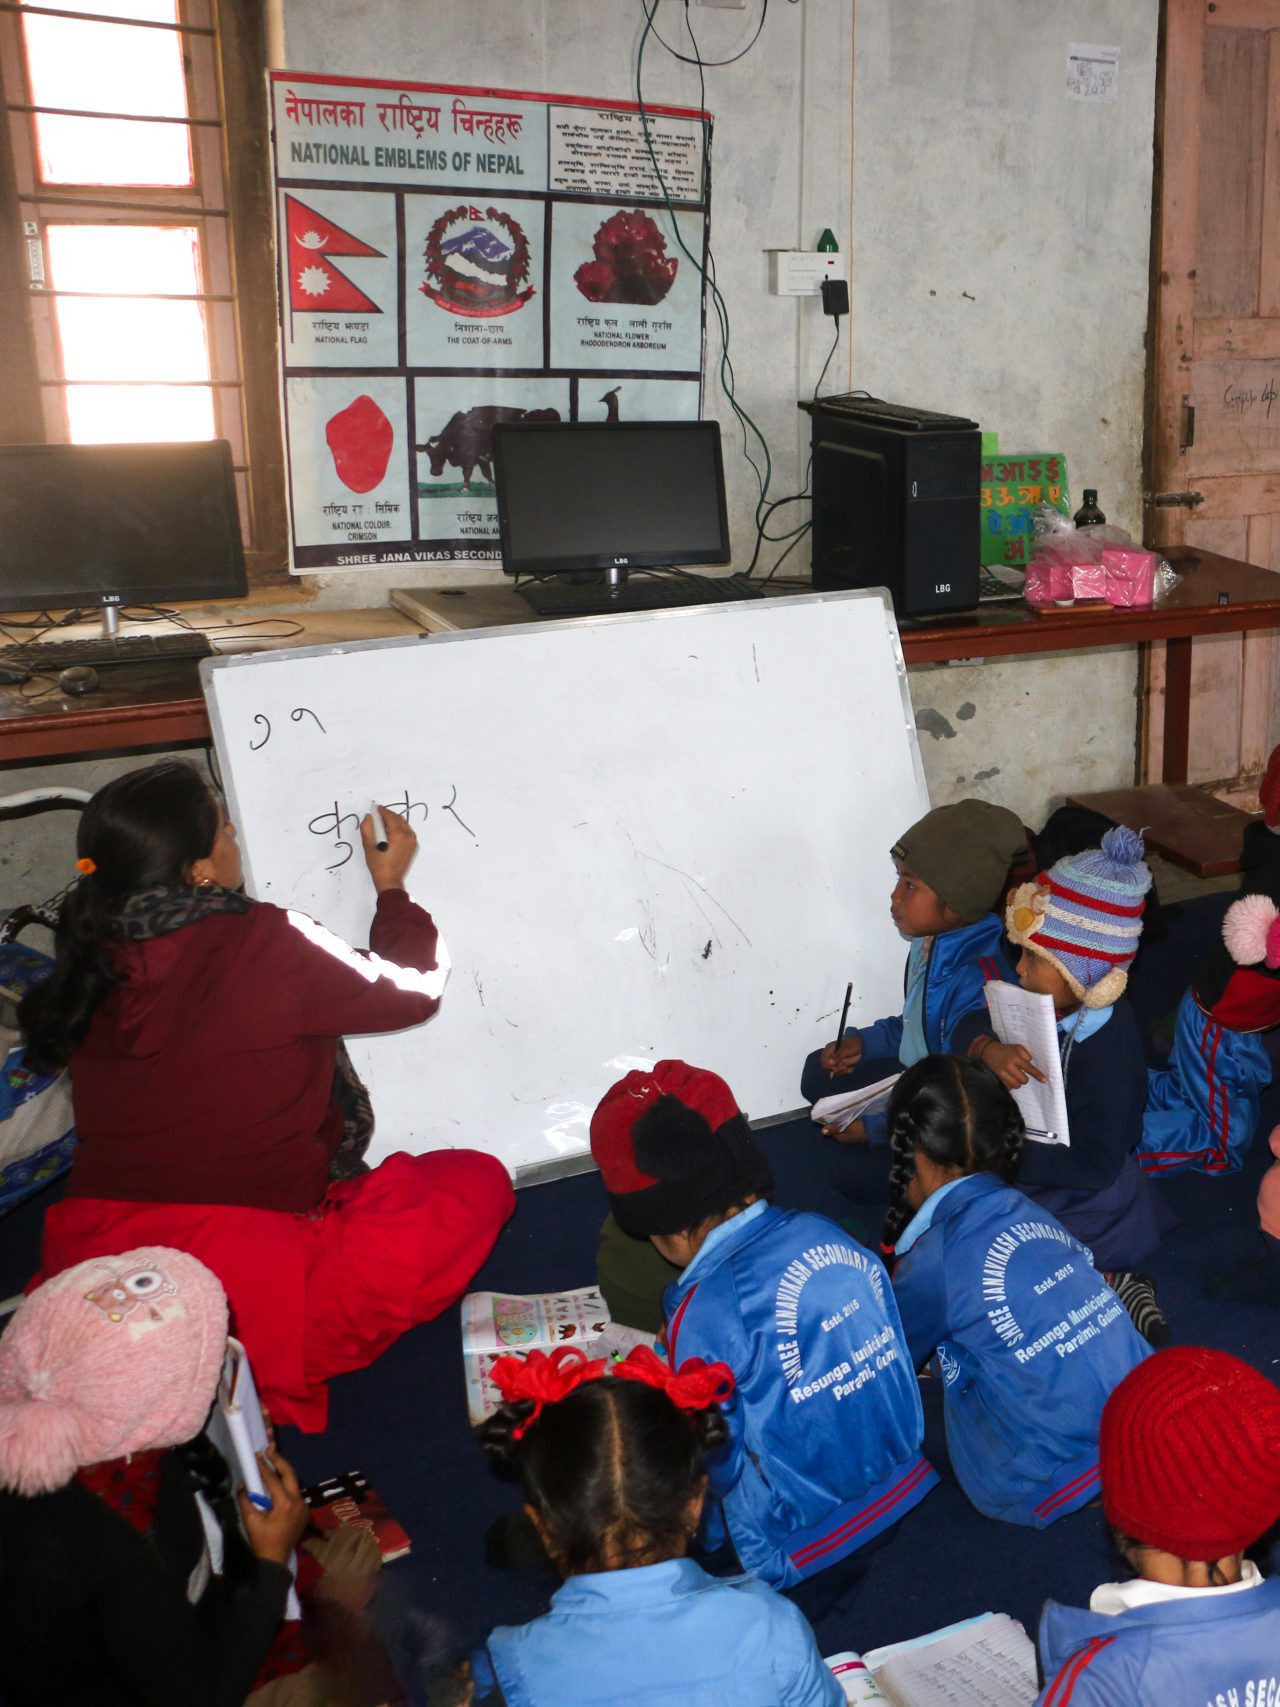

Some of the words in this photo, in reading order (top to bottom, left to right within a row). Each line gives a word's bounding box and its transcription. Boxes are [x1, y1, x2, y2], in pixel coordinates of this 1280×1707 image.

[285, 89, 365, 129] नेपालका
[377, 93, 441, 140] राष्ट्रिय
[291, 142, 370, 166] NATIONAL
[375, 147, 448, 171] EMBLEMS
[452, 152, 471, 172] OF
[476, 153, 525, 175] NEPAL
[314, 336, 348, 344] NATIONAL
[350, 336, 368, 344] FLAG
[447, 336, 460, 344] THE
[462, 336, 513, 345] COAT-OF-ARMS
[581, 340, 631, 348] RHODODENDRON
[632, 341, 667, 350] ARBOREUM
[594, 331, 623, 340] NATIONAL
[332, 521, 363, 530] NATIONAL
[348, 532, 378, 541] CRIMSON
[337, 554, 377, 565] SHREE
[380, 552, 411, 563] JANA
[415, 550, 451, 560] VIKAS
[454, 550, 502, 560] SECOND
[935, 583, 951, 594] LBG
[1010, 1221, 1071, 1248] SECONDARY
[802, 1243, 868, 1272] SECONDARY
[982, 1232, 1020, 1302] JANAVIKASH
[1033, 1277, 1057, 1296] Estd.
[1055, 1263, 1074, 1282] 2015
[775, 1260, 812, 1335] JANAVIKASH
[821, 1311, 844, 1332] Estd.
[988, 1305, 1024, 1347] SHREE
[1097, 1301, 1123, 1328] Gulmi
[1014, 1320, 1071, 1364] Resunga
[778, 1340, 803, 1387] SHREE
[790, 1361, 851, 1404] Resunga
